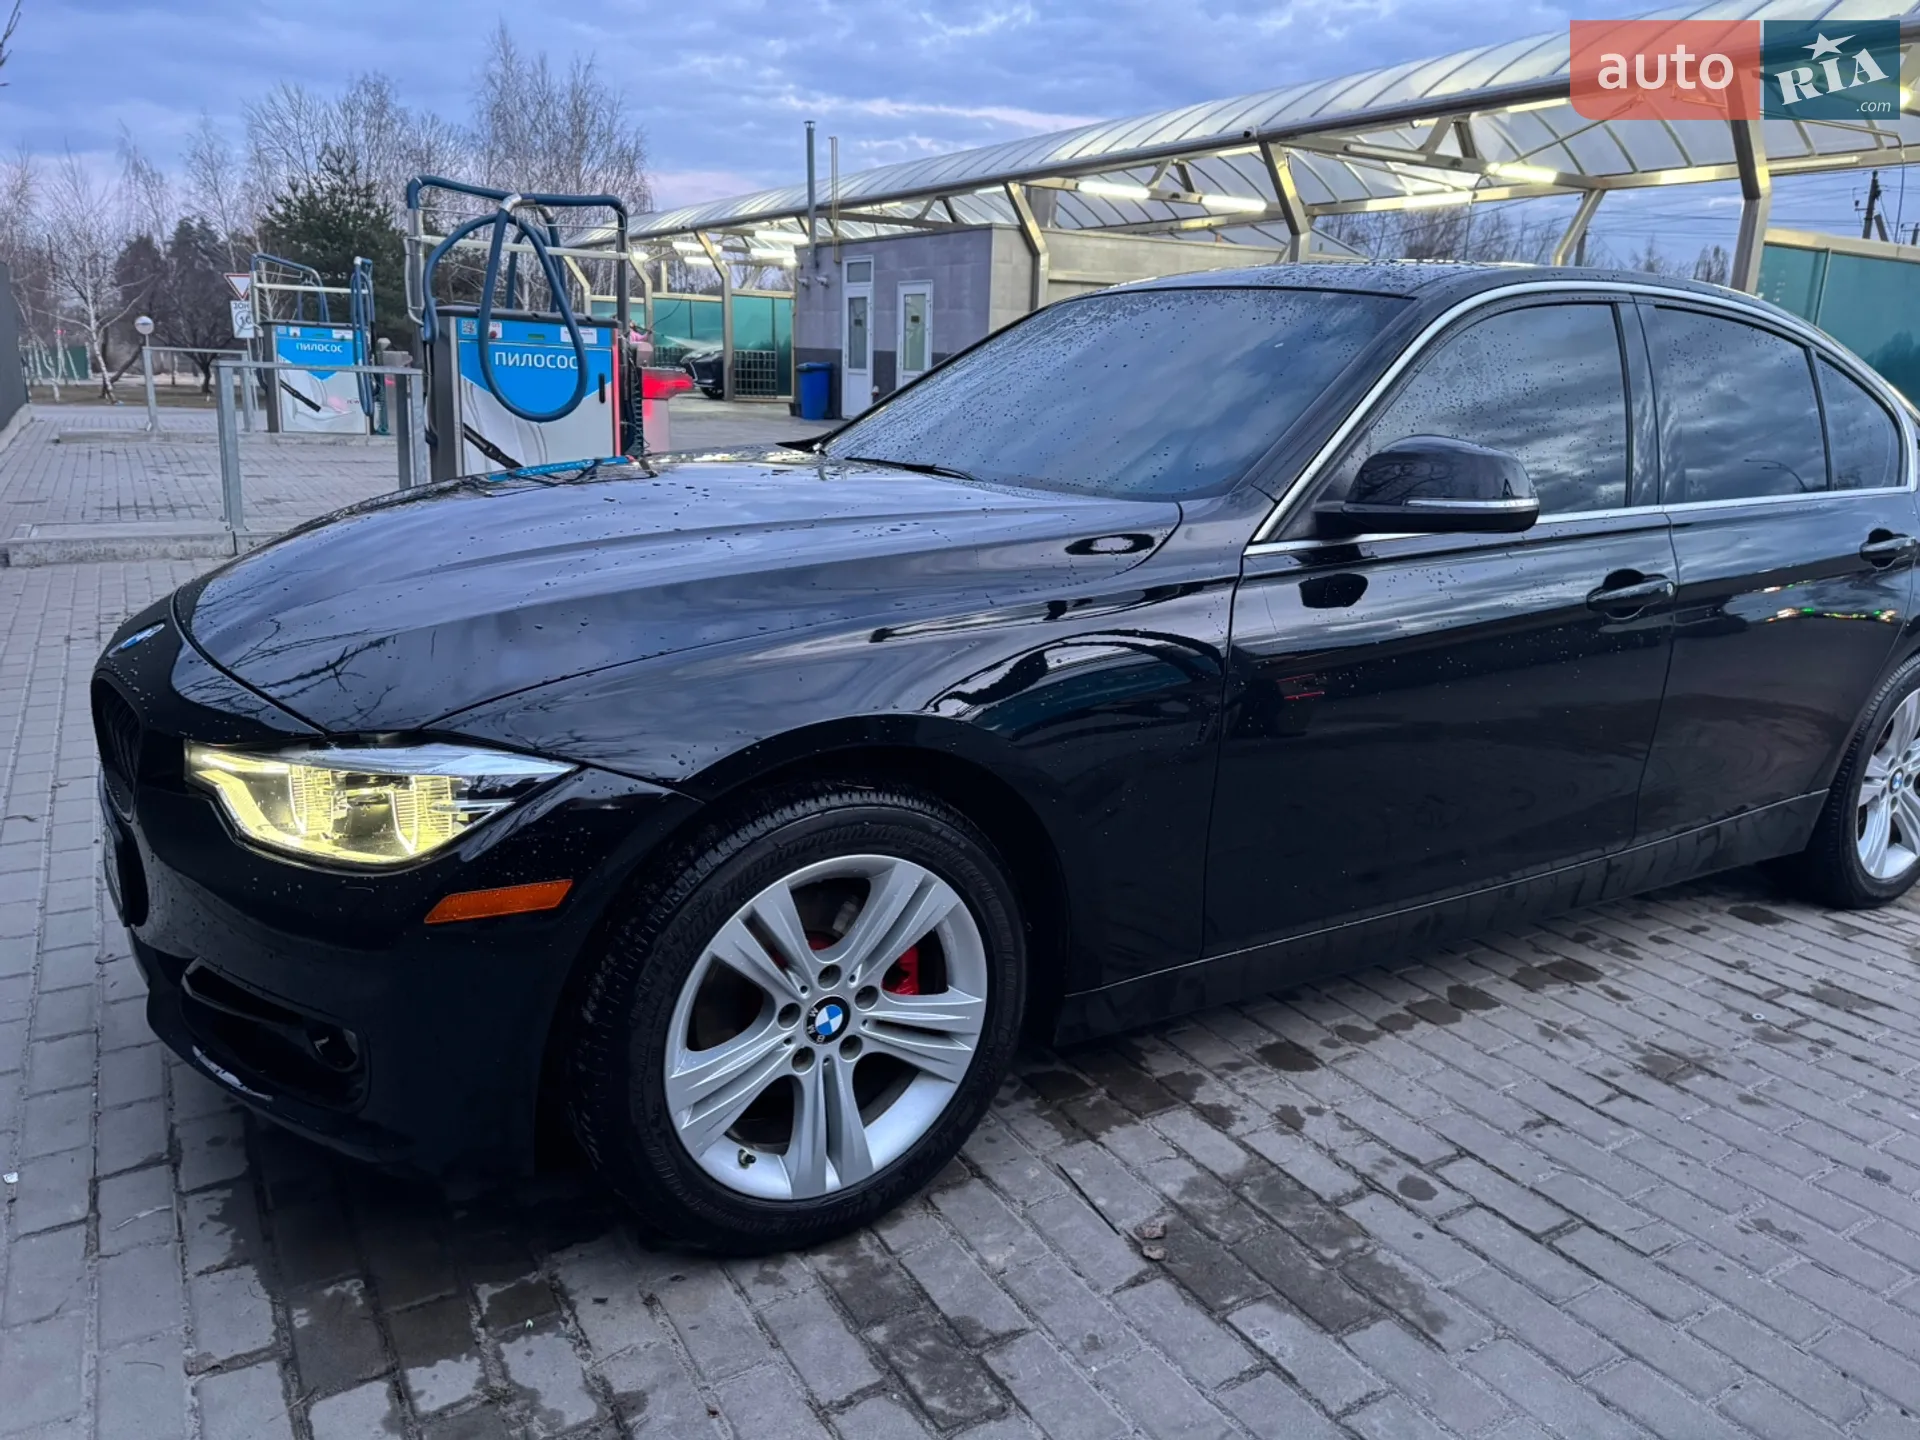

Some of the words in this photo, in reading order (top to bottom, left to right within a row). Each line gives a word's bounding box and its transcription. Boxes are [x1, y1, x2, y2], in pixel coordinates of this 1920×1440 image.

[233, 302, 249, 310] ЗОН
[295, 342, 343, 353] ПИЛОСОС
[494, 351, 578, 369] ПИЛОСОС
